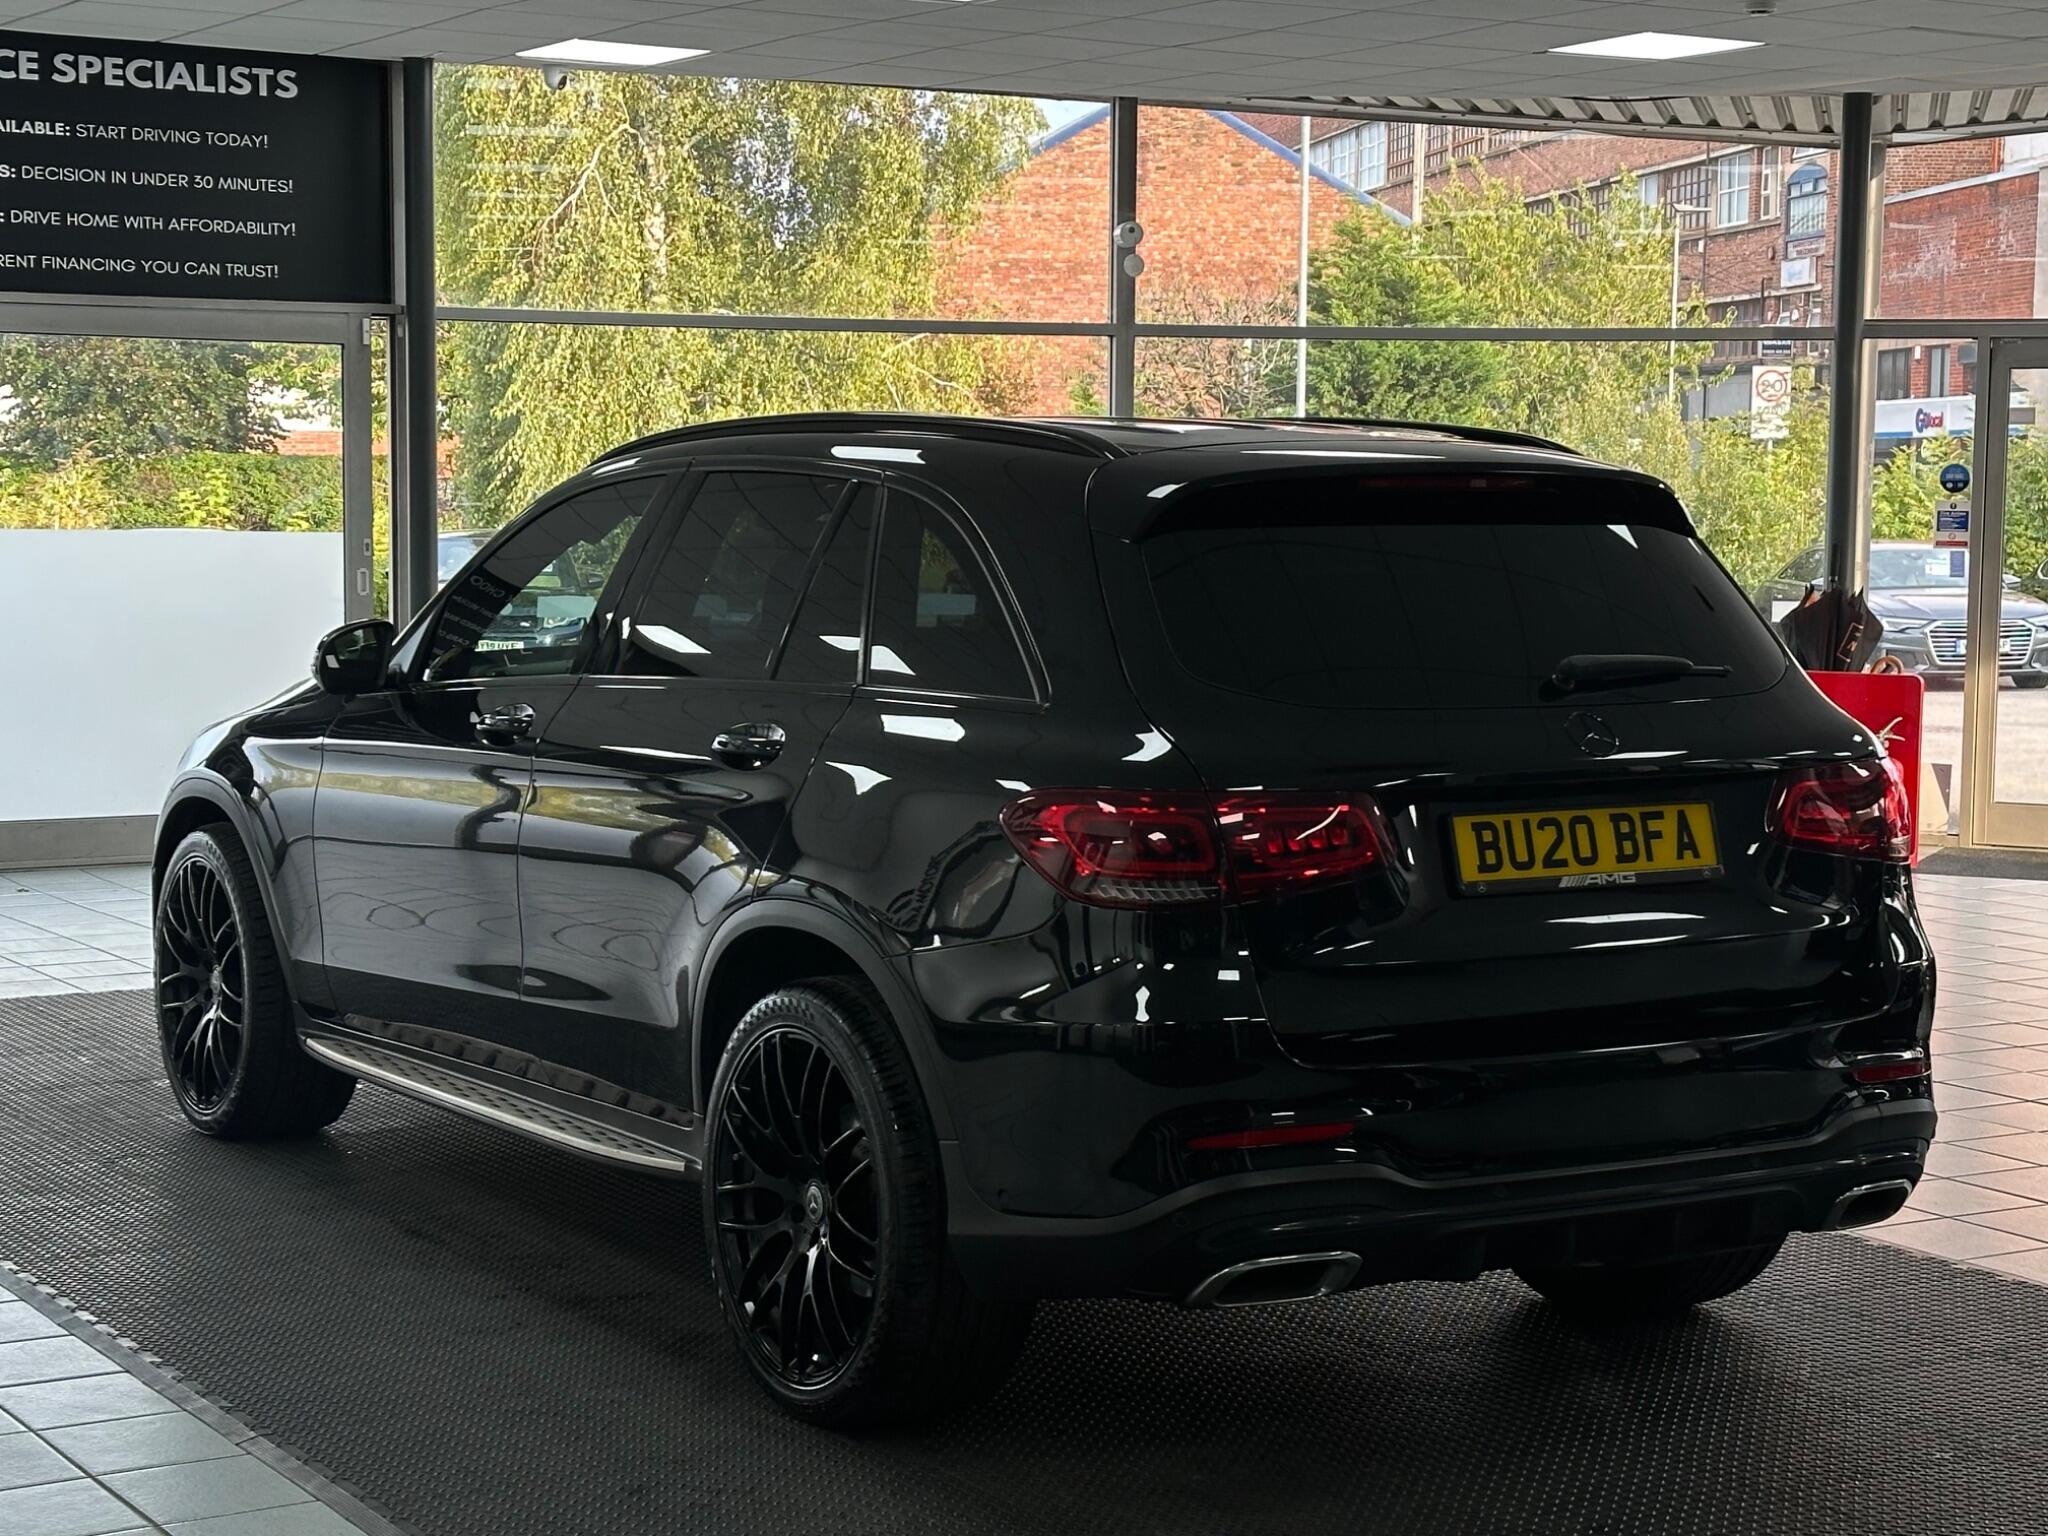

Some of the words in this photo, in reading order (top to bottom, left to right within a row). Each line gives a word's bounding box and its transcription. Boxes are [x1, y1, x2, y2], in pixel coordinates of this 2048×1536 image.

[0, 48, 39, 81] CE
[51, 52, 298, 99] SPECIALISTS
[76, 123, 127, 139] START
[131, 127, 200, 145] DRIVING
[205, 131, 268, 149] TODAY!
[21, 165, 106, 182] DECISION
[111, 170, 127, 184] IN
[131, 171, 189, 188] UNDER
[193, 175, 214, 189] 30
[217, 176, 293, 193] MINUTES!
[10, 209, 61, 225] DRIVE
[66, 212, 119, 228] HOME
[124, 215, 163, 230] WITH
[167, 217, 296, 237] AFFORDABILITY!
[41, 255, 136, 273] FINANCING
[140, 259, 180, 274] YOU
[184, 261, 220, 276] CAN
[225, 263, 279, 279] TRUST!
[1760, 379, 1783, 394] 20
[1470, 815, 1599, 874] BU20
[1608, 808, 1701, 864] BFA
[1583, 872, 1637, 886] AMG
